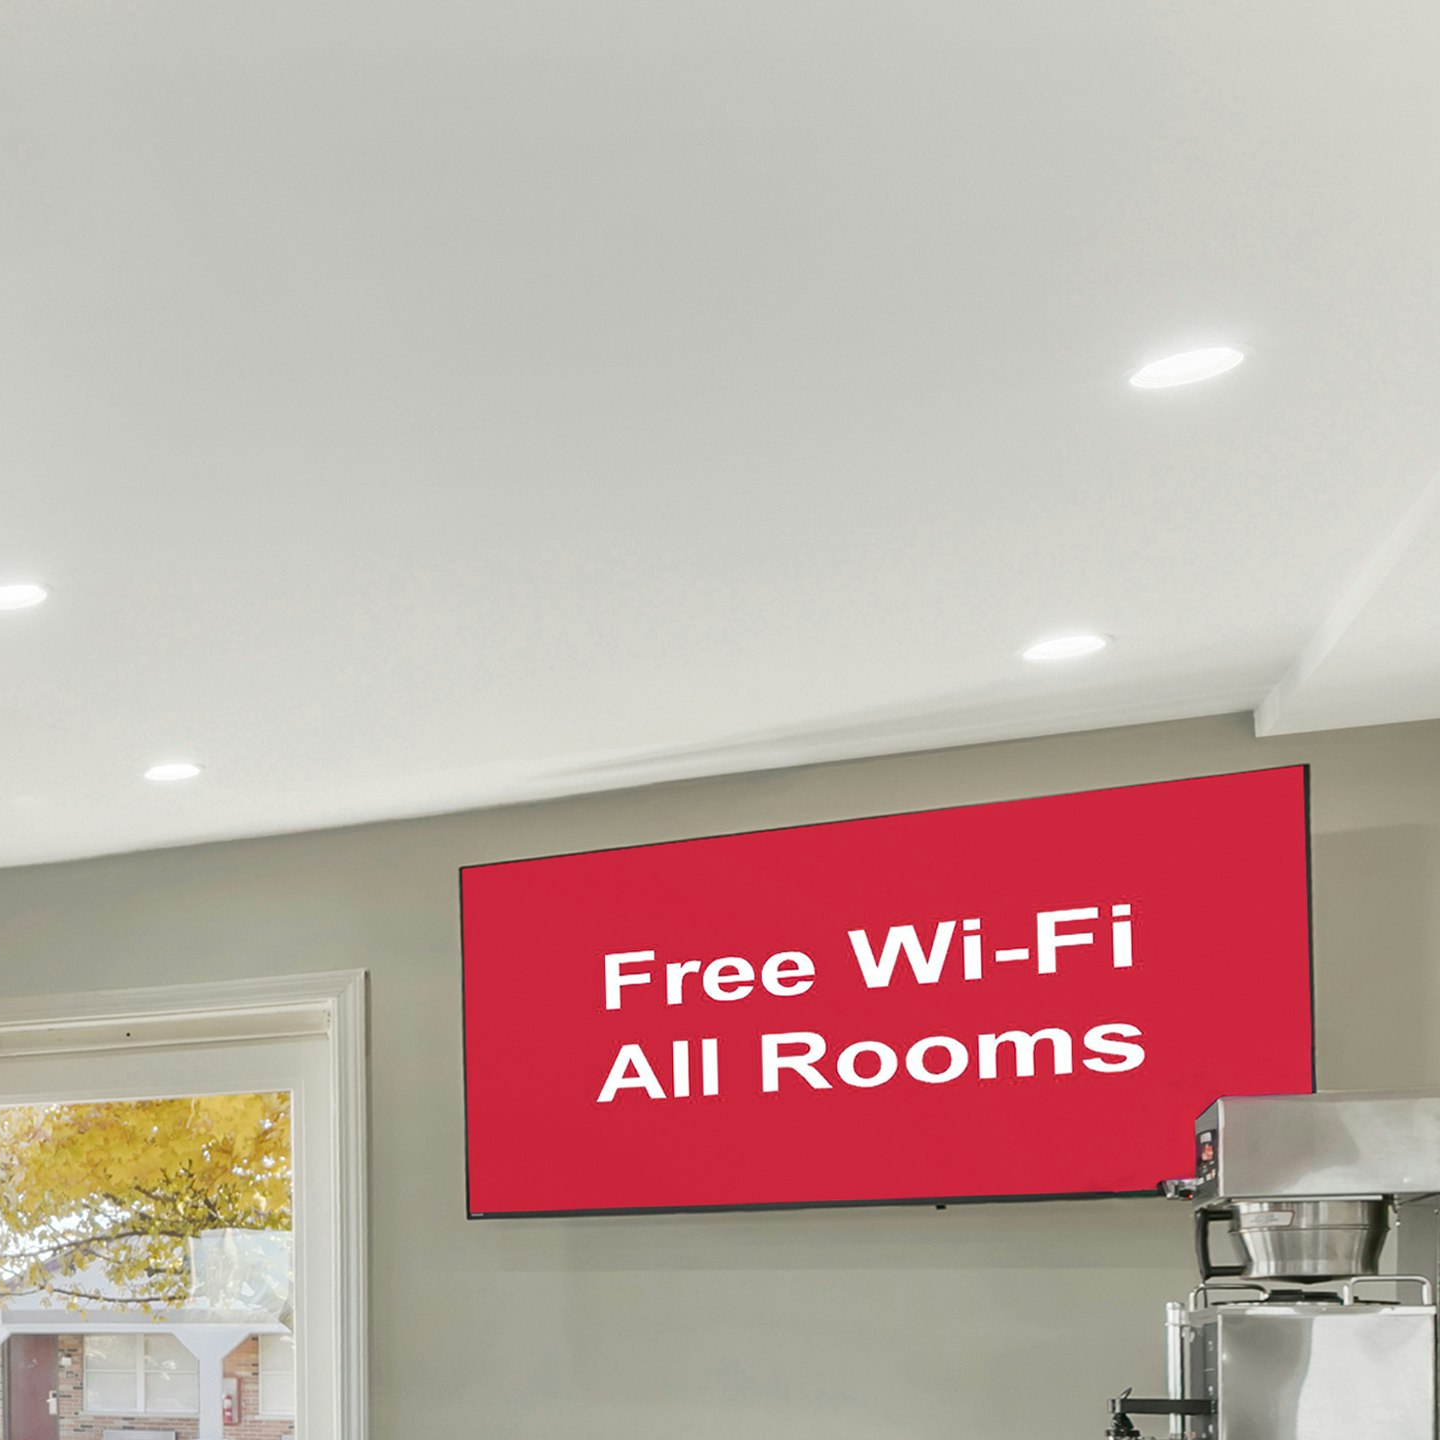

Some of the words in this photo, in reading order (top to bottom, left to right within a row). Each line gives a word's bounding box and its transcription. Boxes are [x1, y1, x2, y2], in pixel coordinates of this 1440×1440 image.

[604, 950, 816, 1009] Free
[848, 904, 1133, 988] Wi-Fi
[596, 1038, 720, 1102] All
[762, 1023, 1145, 1092] Rooms
